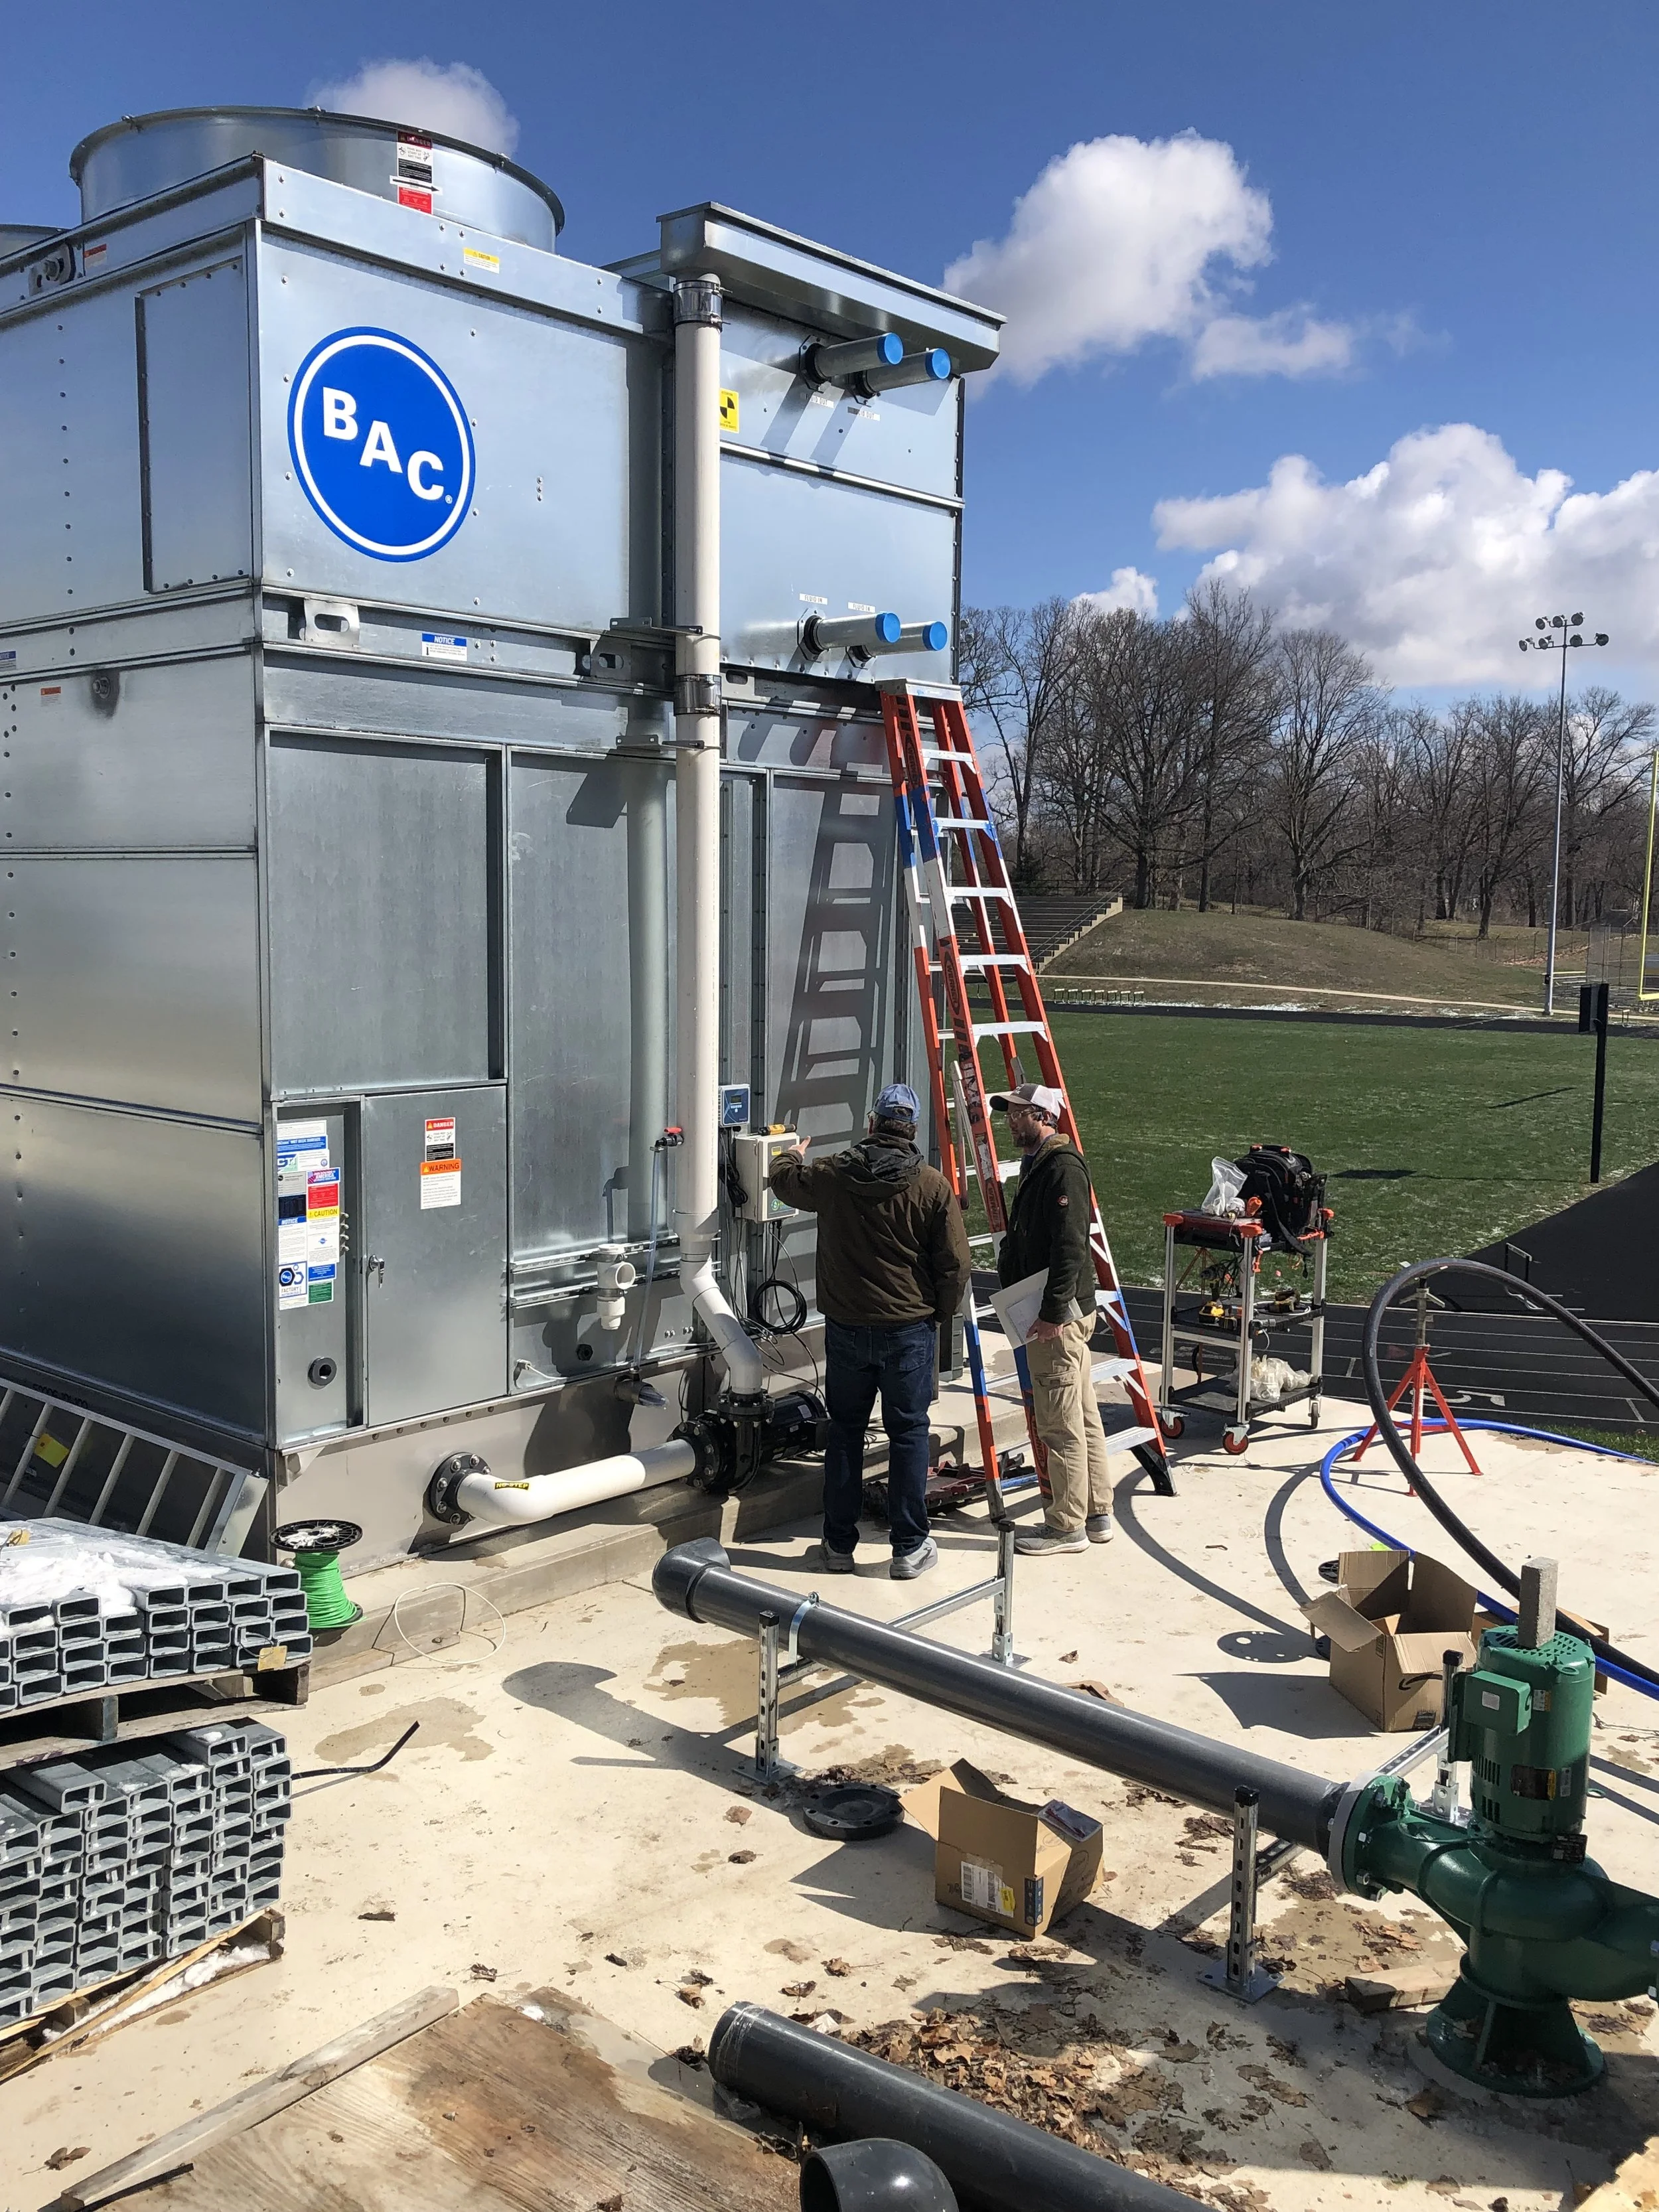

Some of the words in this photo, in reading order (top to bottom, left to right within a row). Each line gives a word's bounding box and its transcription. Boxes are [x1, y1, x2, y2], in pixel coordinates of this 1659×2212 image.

[323, 386, 445, 502] BAC
[434, 636, 455, 644] NOTICE
[947, 964, 958, 1003] WERNER
[429, 1163, 460, 1171] WARNING
